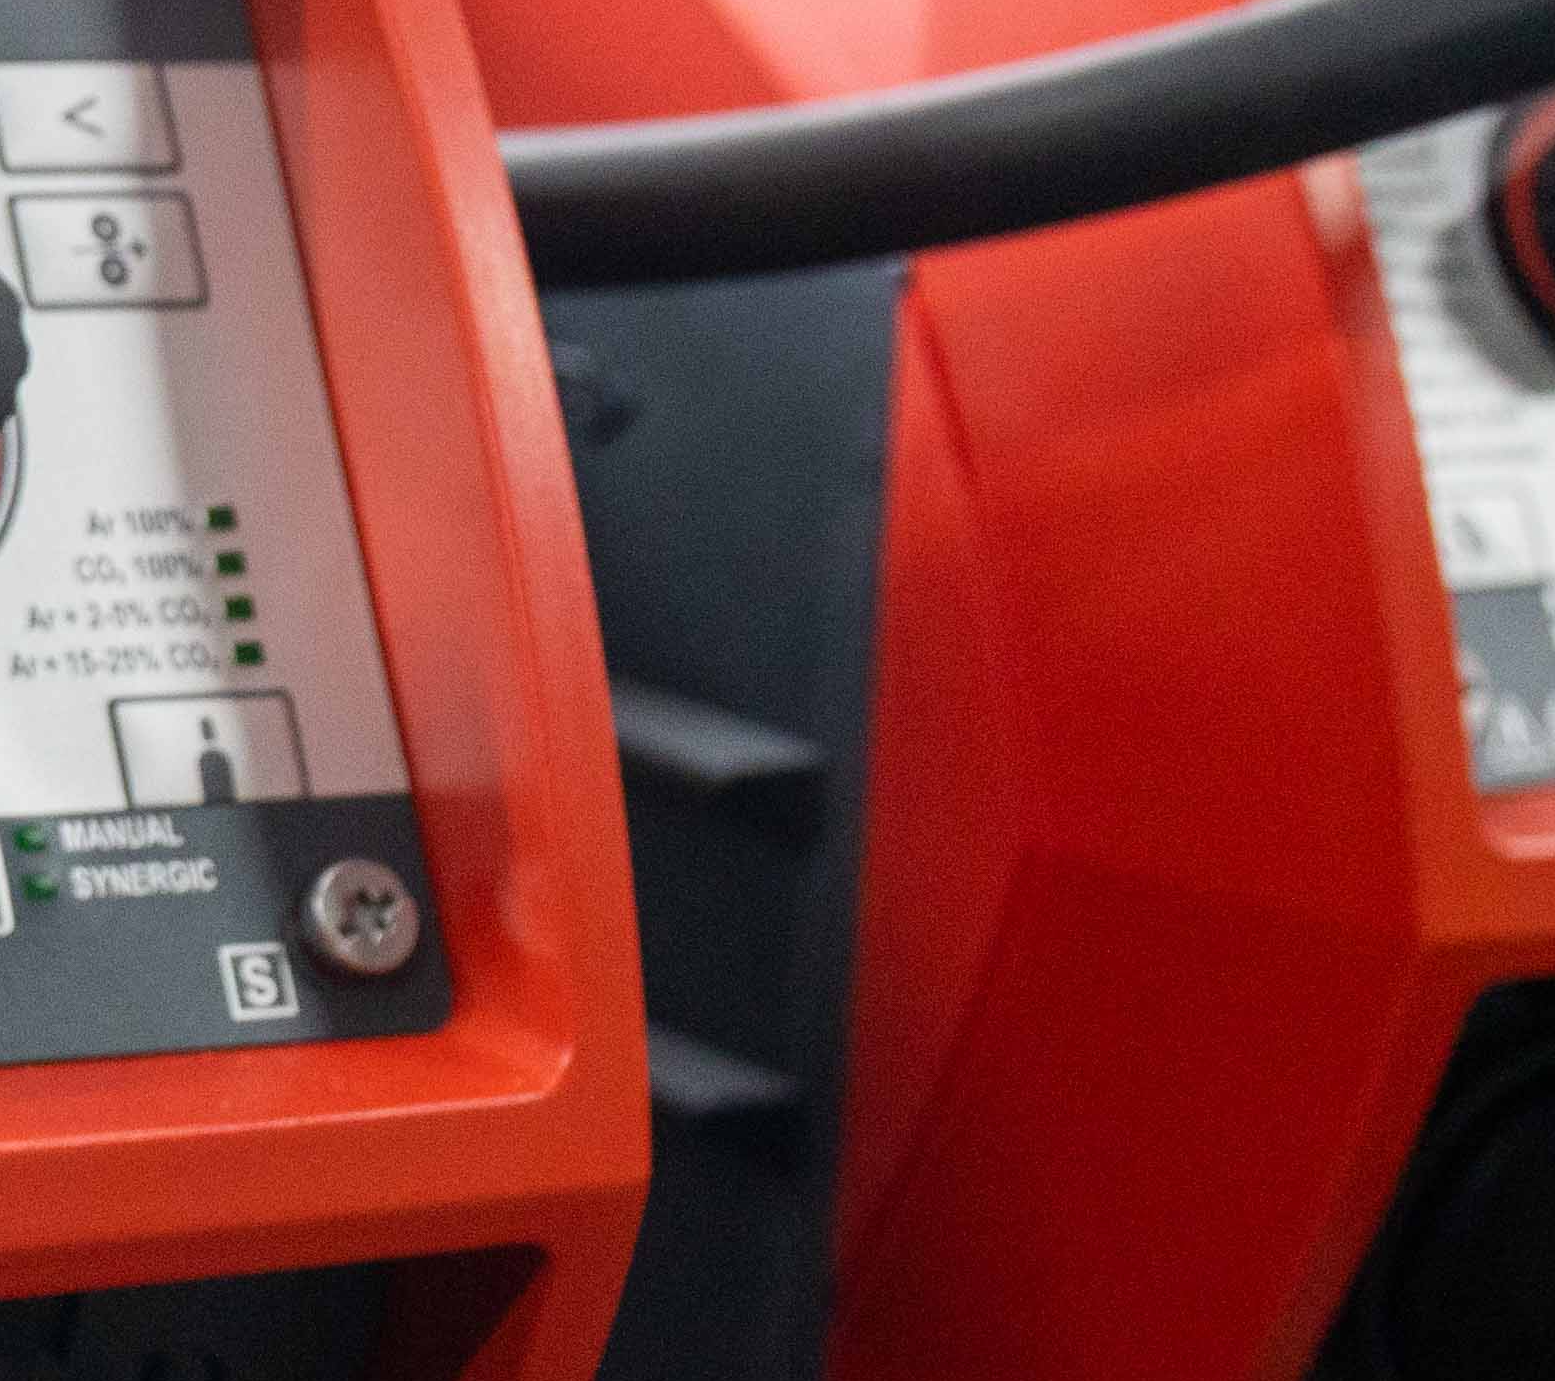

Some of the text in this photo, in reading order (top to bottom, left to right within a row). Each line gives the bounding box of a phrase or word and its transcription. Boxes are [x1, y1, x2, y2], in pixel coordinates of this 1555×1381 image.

[58, 814, 185, 852] MANUAL
[69, 856, 219, 902] SYNERGIC
[239, 955, 280, 1006] S
